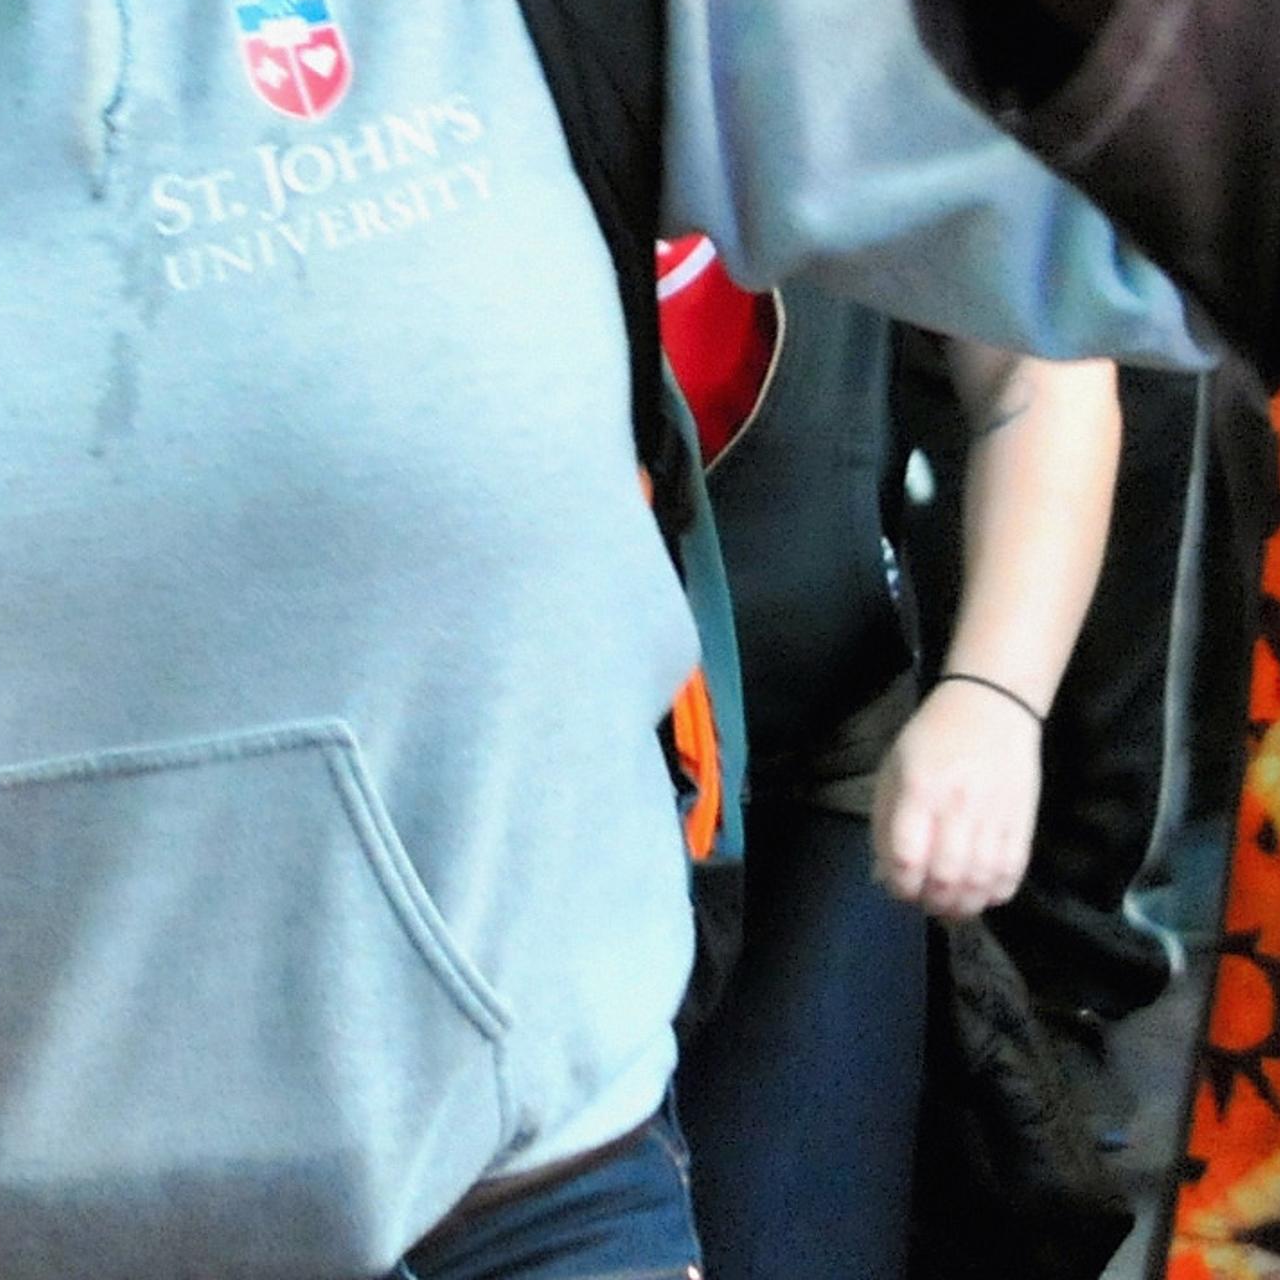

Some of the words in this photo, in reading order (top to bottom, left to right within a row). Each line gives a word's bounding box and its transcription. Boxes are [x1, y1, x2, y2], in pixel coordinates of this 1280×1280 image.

[150, 169, 247, 237] ST.
[253, 92, 484, 222] JOHN'S
[162, 158, 494, 292] UNIVERSITY
